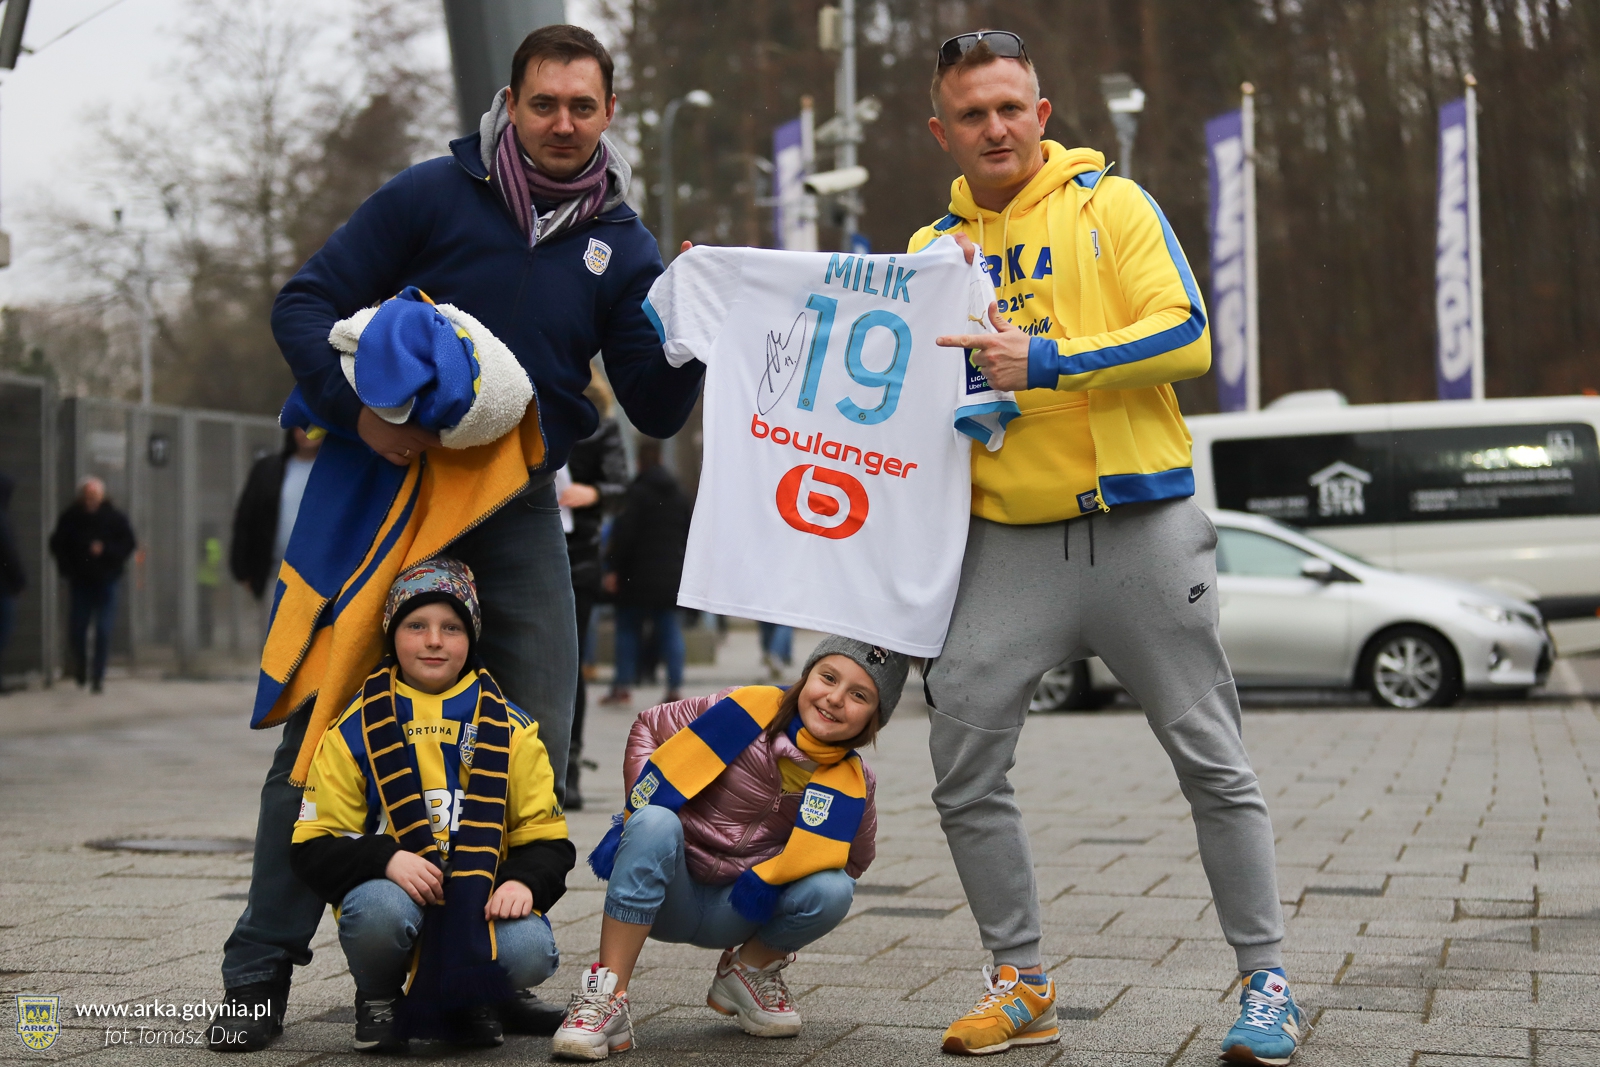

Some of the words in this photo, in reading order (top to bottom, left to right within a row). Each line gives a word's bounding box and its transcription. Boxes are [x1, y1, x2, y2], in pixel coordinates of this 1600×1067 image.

[984, 244, 1053, 288] RKA
[997, 293, 1035, 313] 929-
[797, 293, 912, 426] 19
[970, 375, 988, 383] LIGU
[751, 414, 918, 479] boulanger
[1190, 582, 1204, 596] NIKE
[408, 725, 452, 737] ORTUNA
[804, 807, 825, 818] ARKA
